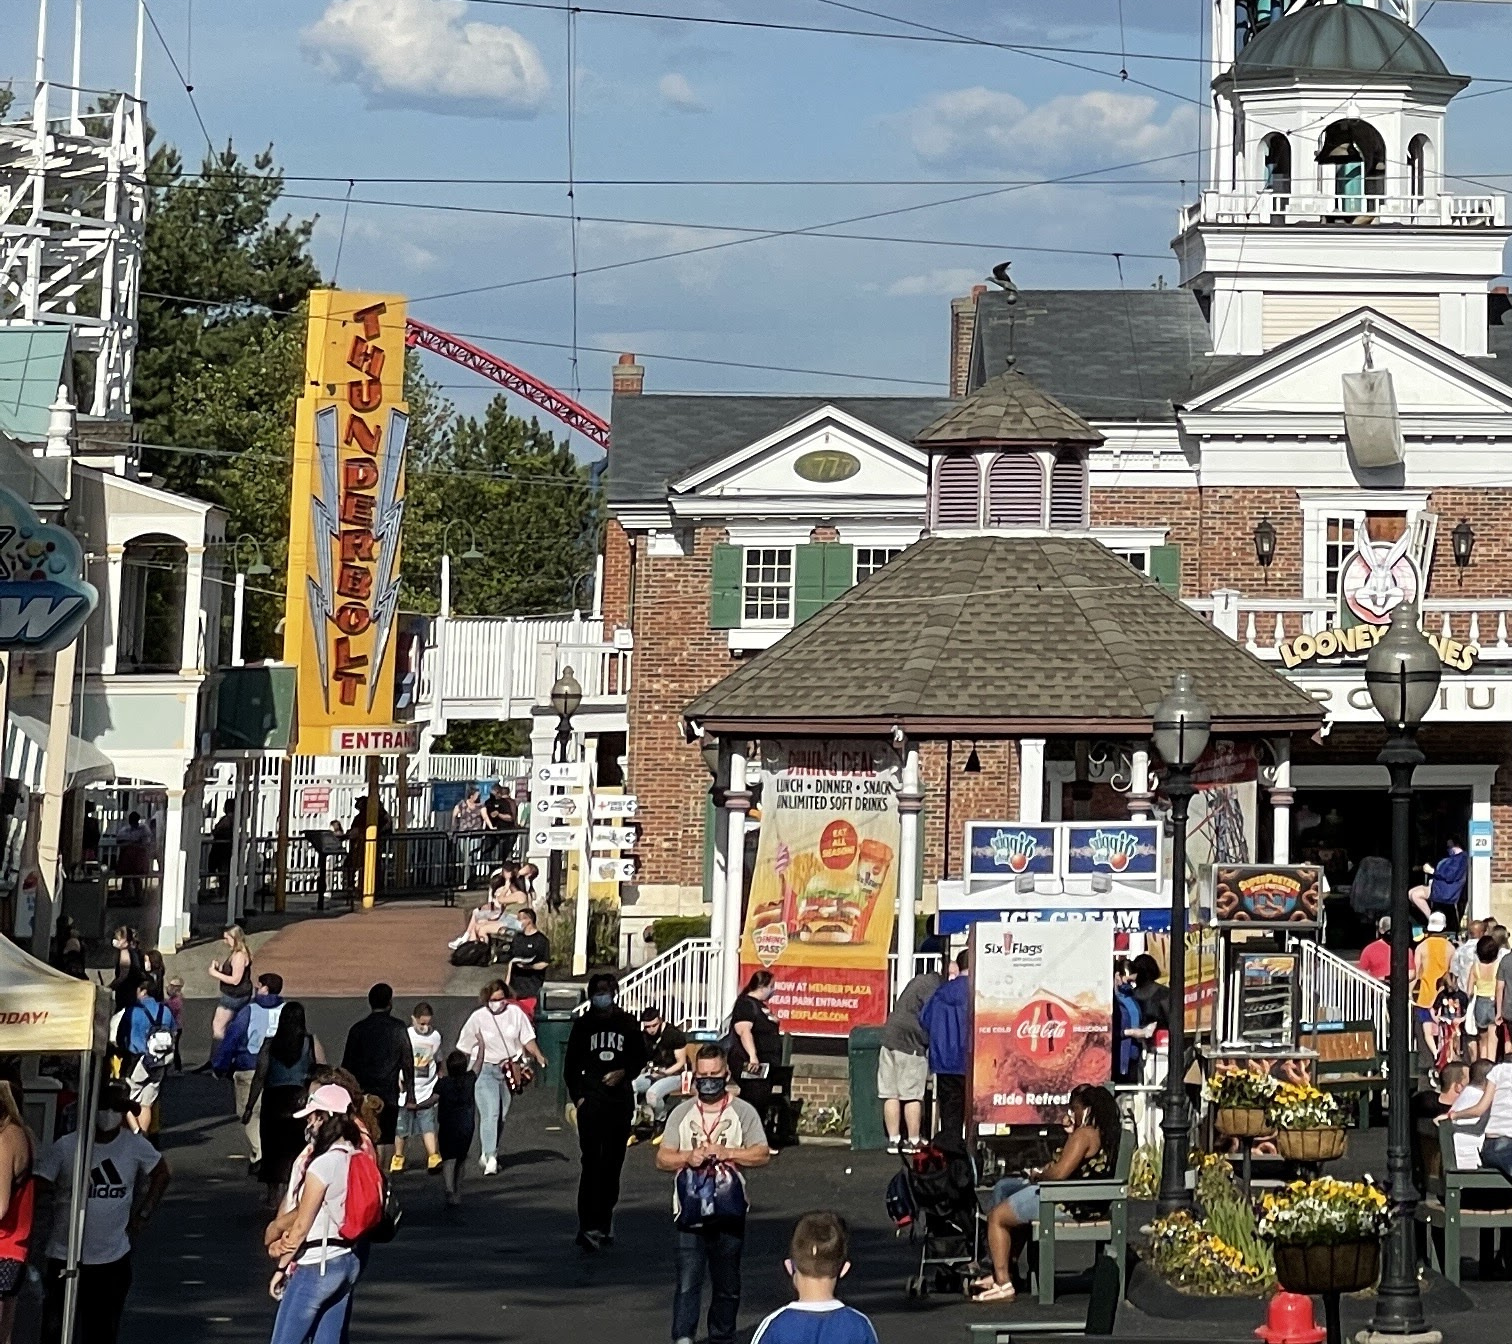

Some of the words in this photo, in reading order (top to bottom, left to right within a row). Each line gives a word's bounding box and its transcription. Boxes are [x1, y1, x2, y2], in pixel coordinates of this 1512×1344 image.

[333, 301, 388, 706] THUNDERBOLT
[1279, 624, 1389, 669] LOONEY
[1421, 630, 1479, 672] NES
[815, 779, 853, 794] DINNER
[829, 796, 854, 811] SOFT
[854, 797, 888, 812] DRINKS
[984, 943, 1003, 955] Six
[1012, 942, 1043, 956] Flags
[589, 1031, 625, 1052] NIKE
[992, 1092, 1023, 1106] Ride
